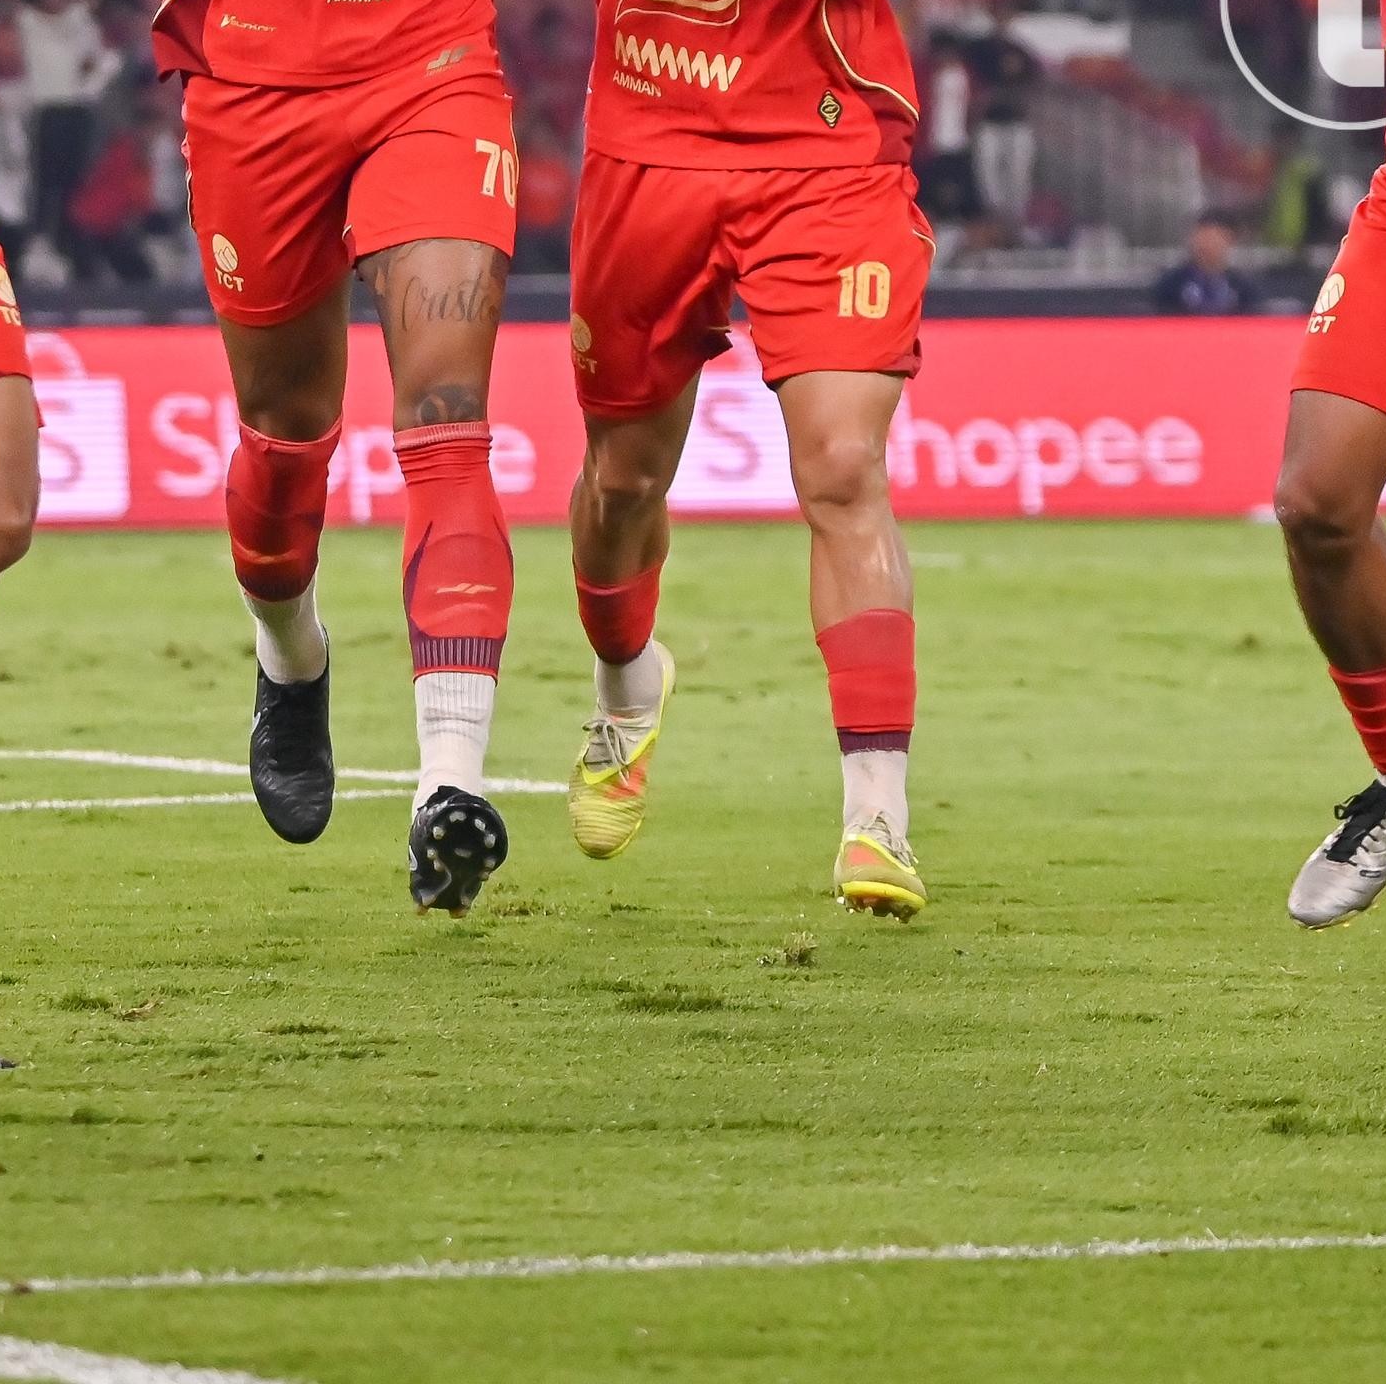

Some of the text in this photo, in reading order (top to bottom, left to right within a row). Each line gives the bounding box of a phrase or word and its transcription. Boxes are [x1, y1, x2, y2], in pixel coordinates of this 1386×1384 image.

[613, 70, 662, 98] AMMAN
[474, 137, 517, 209] 70
[214, 266, 245, 293] TCT
[838, 261, 892, 320] 10
[1307, 315, 1338, 335] CT
[888, 391, 1205, 516] hopee
